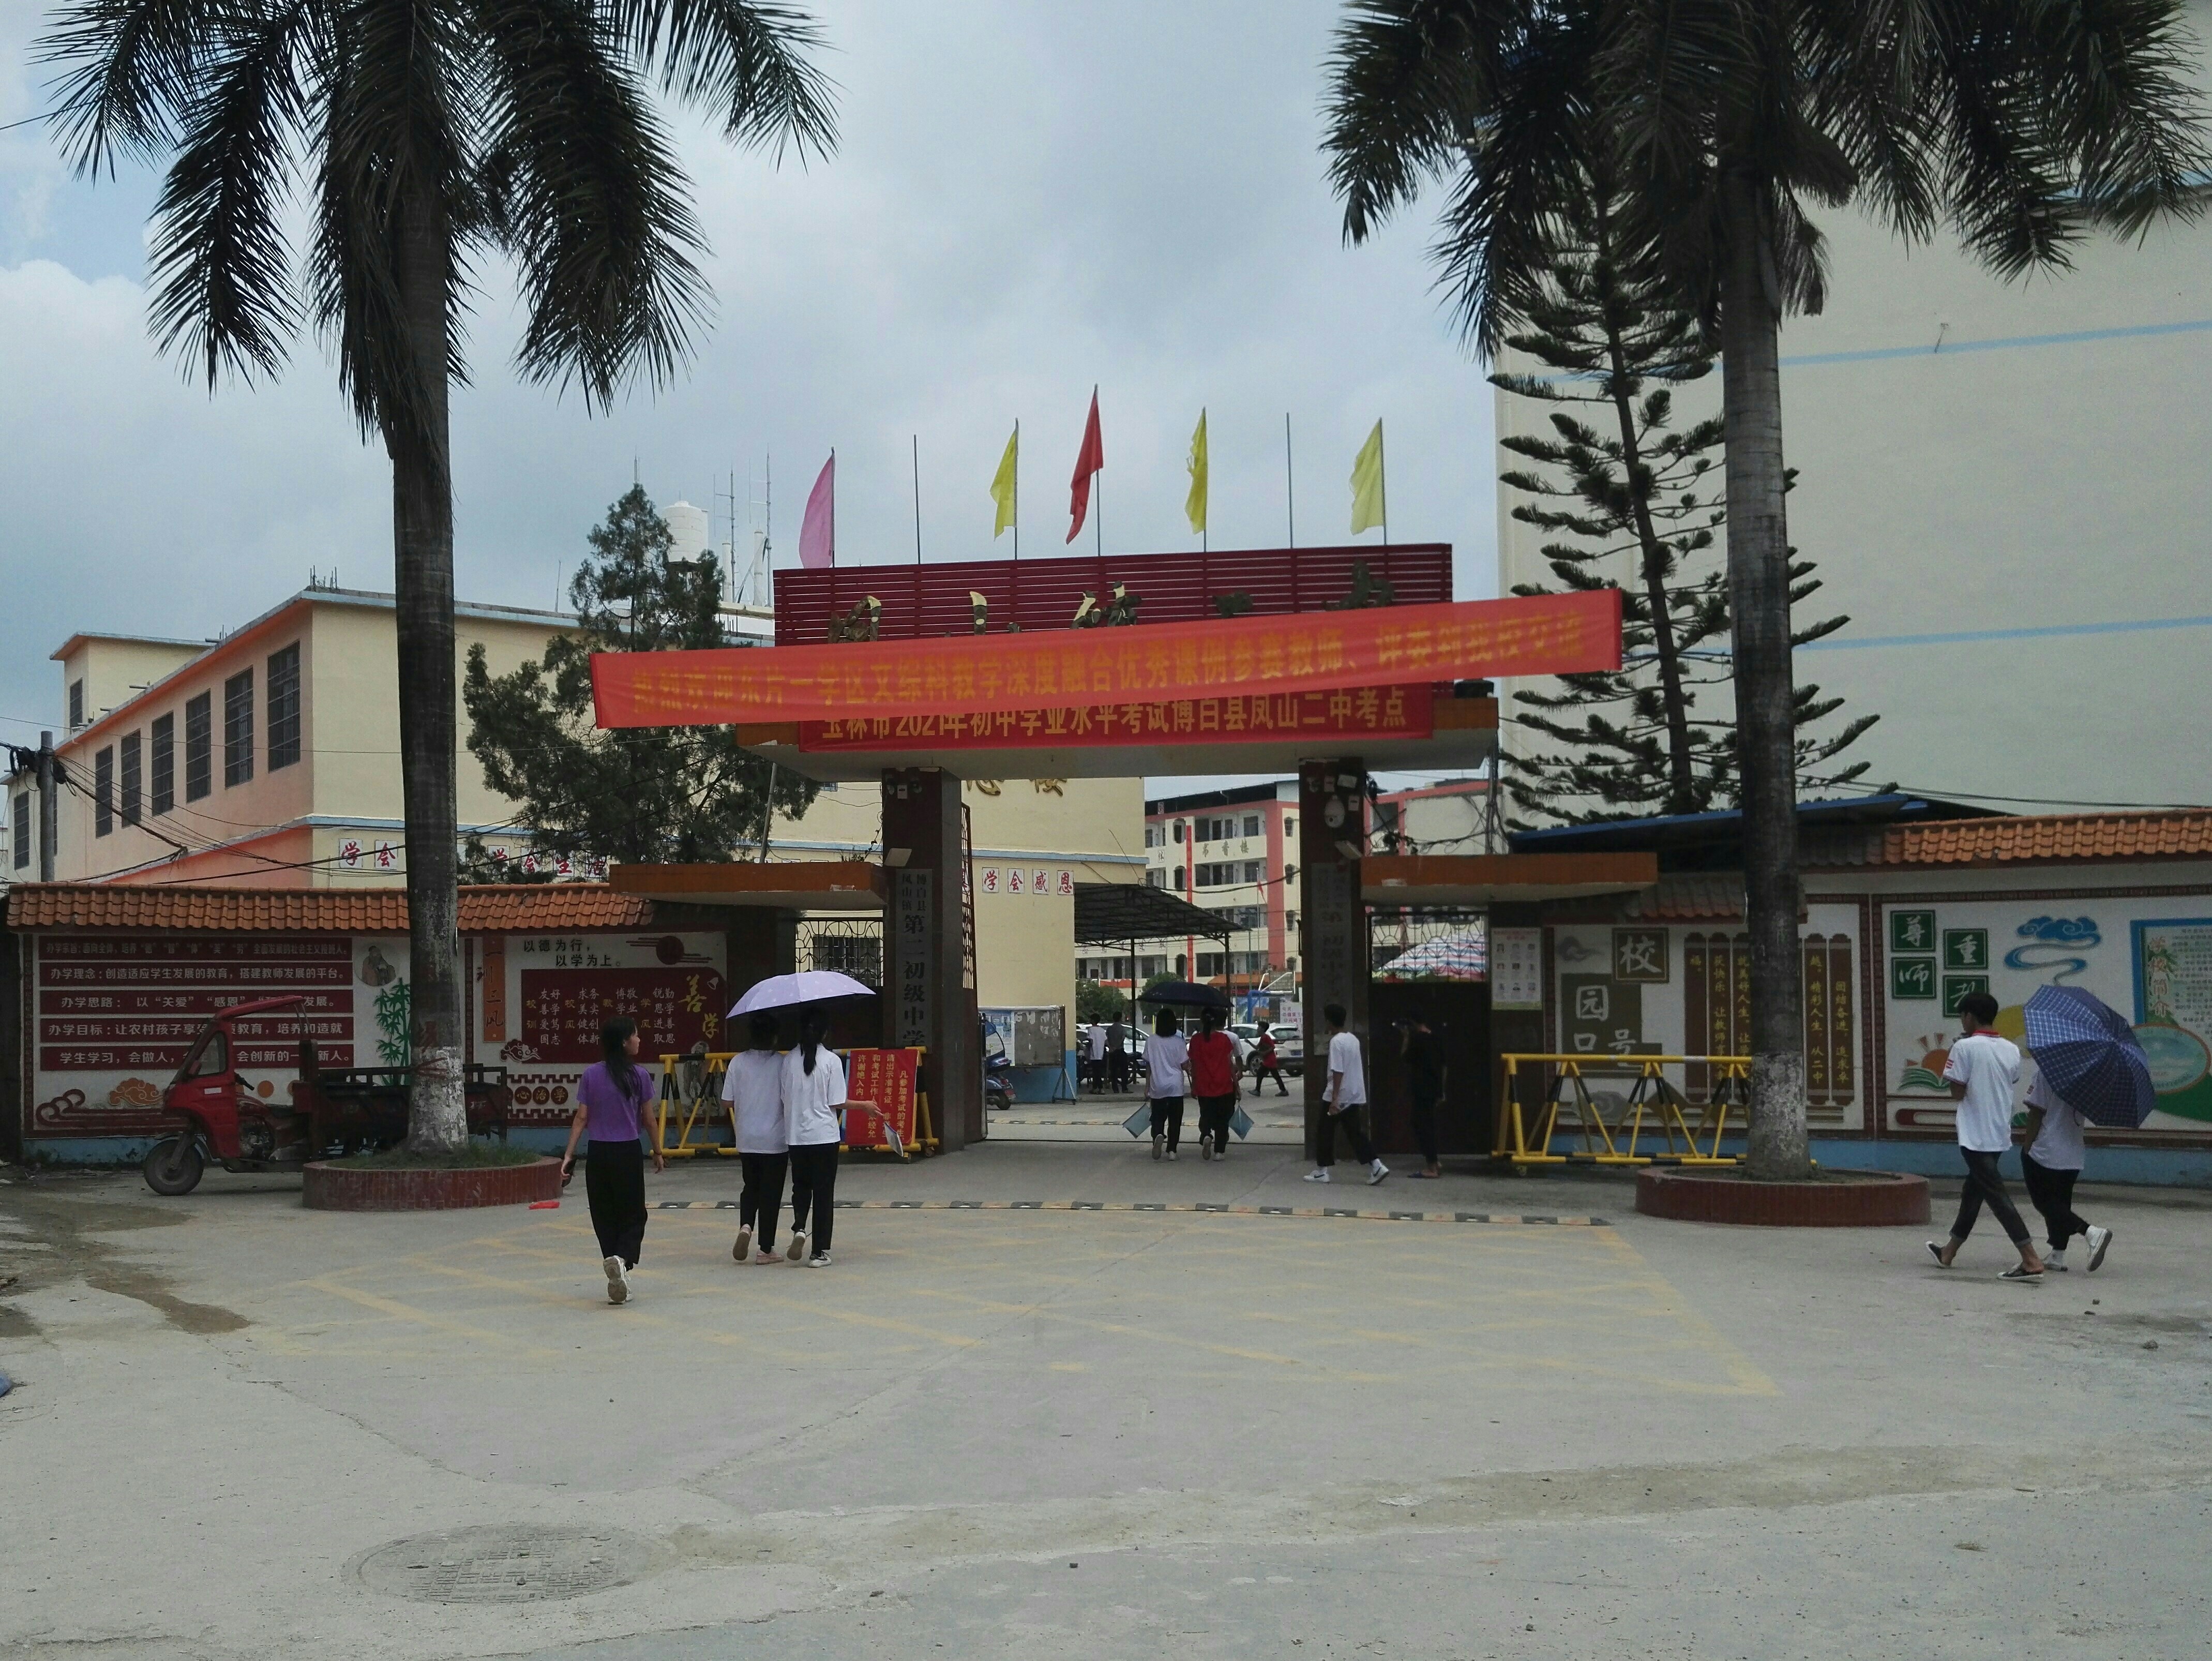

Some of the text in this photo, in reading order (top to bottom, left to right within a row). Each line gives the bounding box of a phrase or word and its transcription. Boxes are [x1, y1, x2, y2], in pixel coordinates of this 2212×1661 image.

[984, 869, 1072, 893] 学会感恩
[516, 1088, 566, 1102] 心治学
